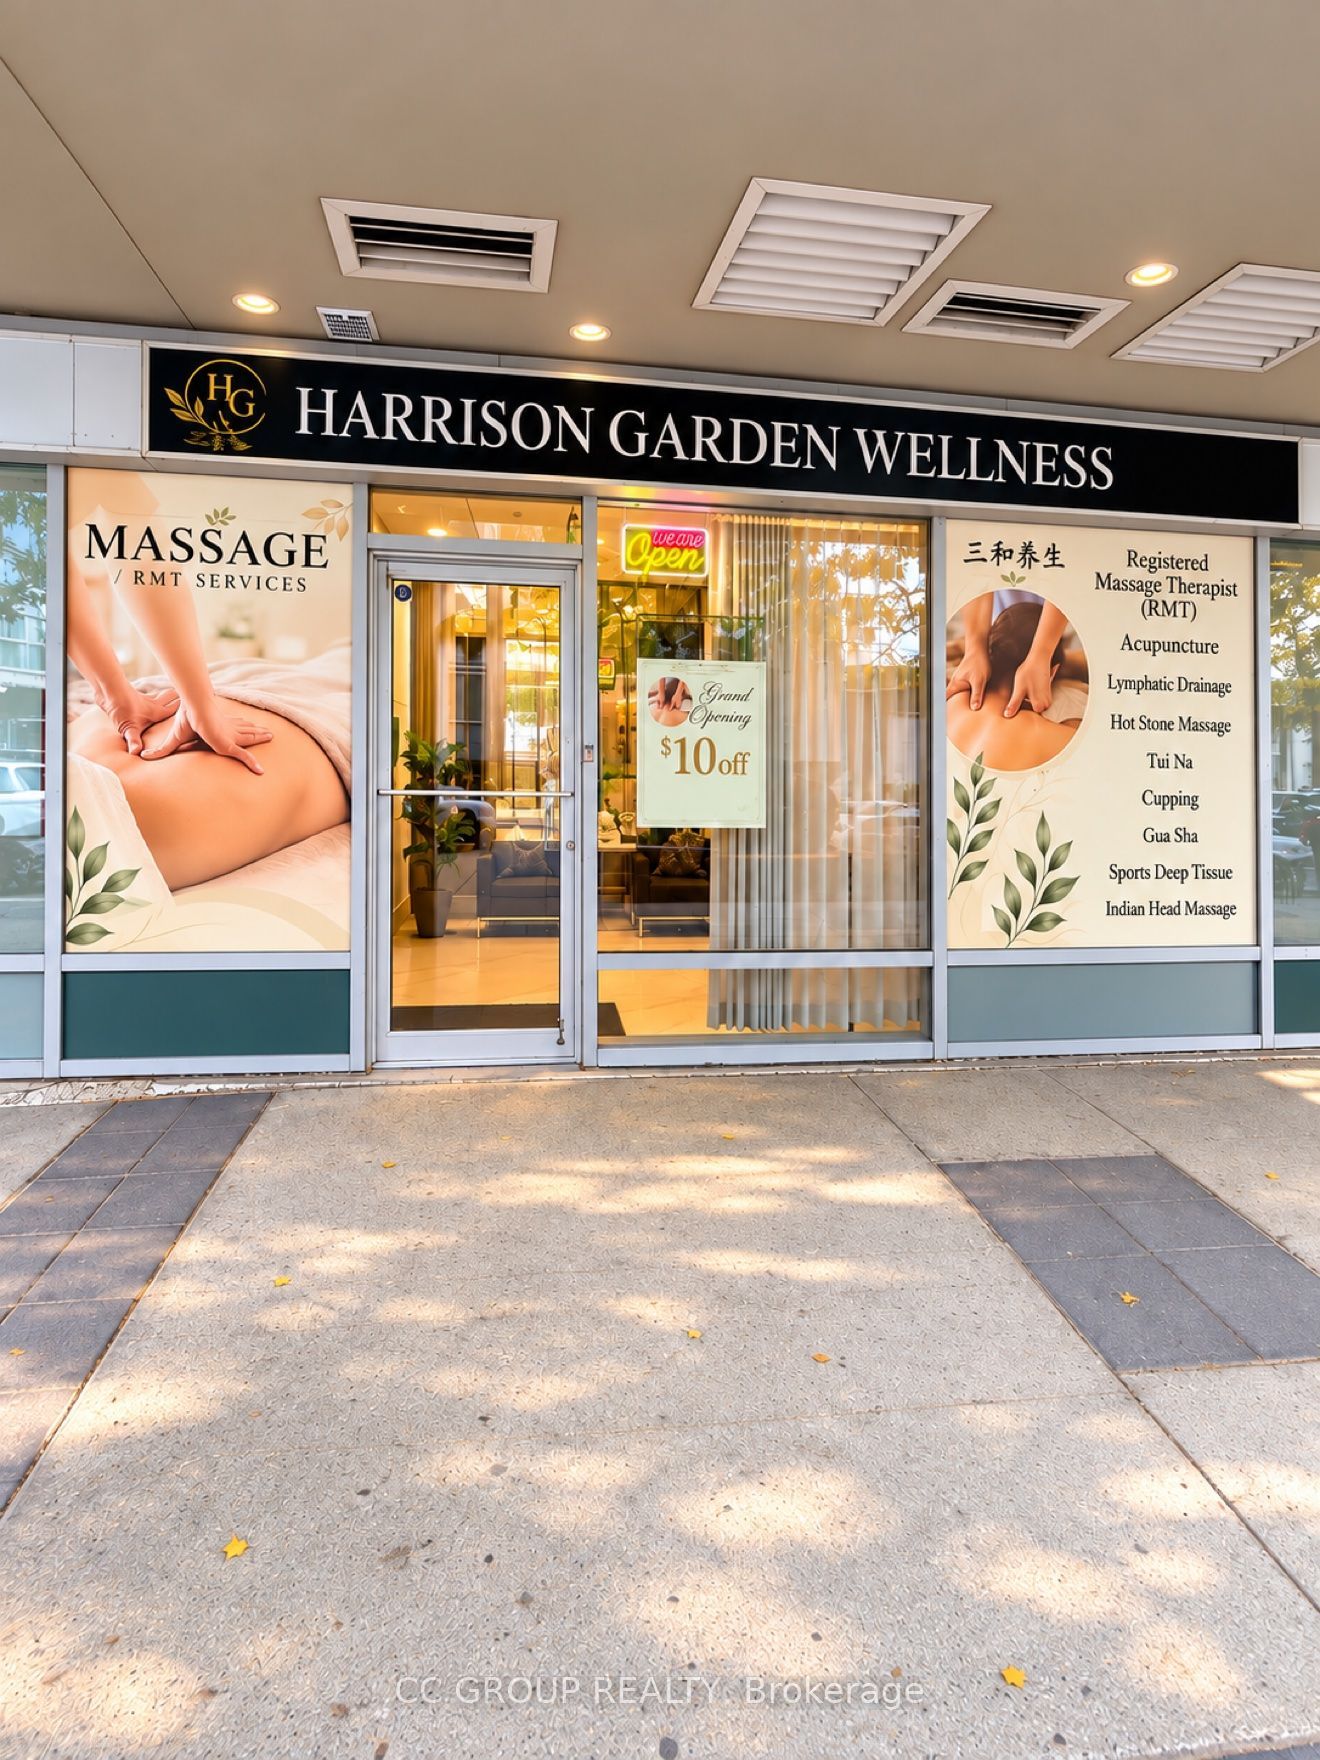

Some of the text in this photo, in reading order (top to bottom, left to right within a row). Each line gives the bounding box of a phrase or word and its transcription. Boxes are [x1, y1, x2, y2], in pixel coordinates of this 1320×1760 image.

[296, 386, 1115, 491] HARRISON GARDEN WELLNESS
[85, 523, 328, 569] MASSAGE
[652, 531, 705, 548] we are
[627, 532, 705, 582] Open
[963, 540, 1065, 570] 三和养生
[1126, 549, 1209, 574] Registered
[134, 570, 182, 587] RMT
[196, 573, 307, 592] SERVICES
[1095, 571, 1238, 601] Massage Therapist
[1141, 599, 1197, 622] (RMT)
[1120, 634, 1219, 657] Acupuncture
[699, 681, 753, 705] Grand
[1107, 674, 1232, 697] Lymphatic Drainage
[688, 705, 752, 730] Opening
[1110, 714, 1231, 737] Hot Stone Massage
[718, 752, 749, 776] off
[1147, 752, 1193, 770] Tui Na
[1141, 790, 1199, 811] Cupping
[1143, 827, 1198, 844] Gua Sha
[1109, 864, 1232, 885] Sports Deep Tissue
[1106, 901, 1237, 921] Indian Head Massage
